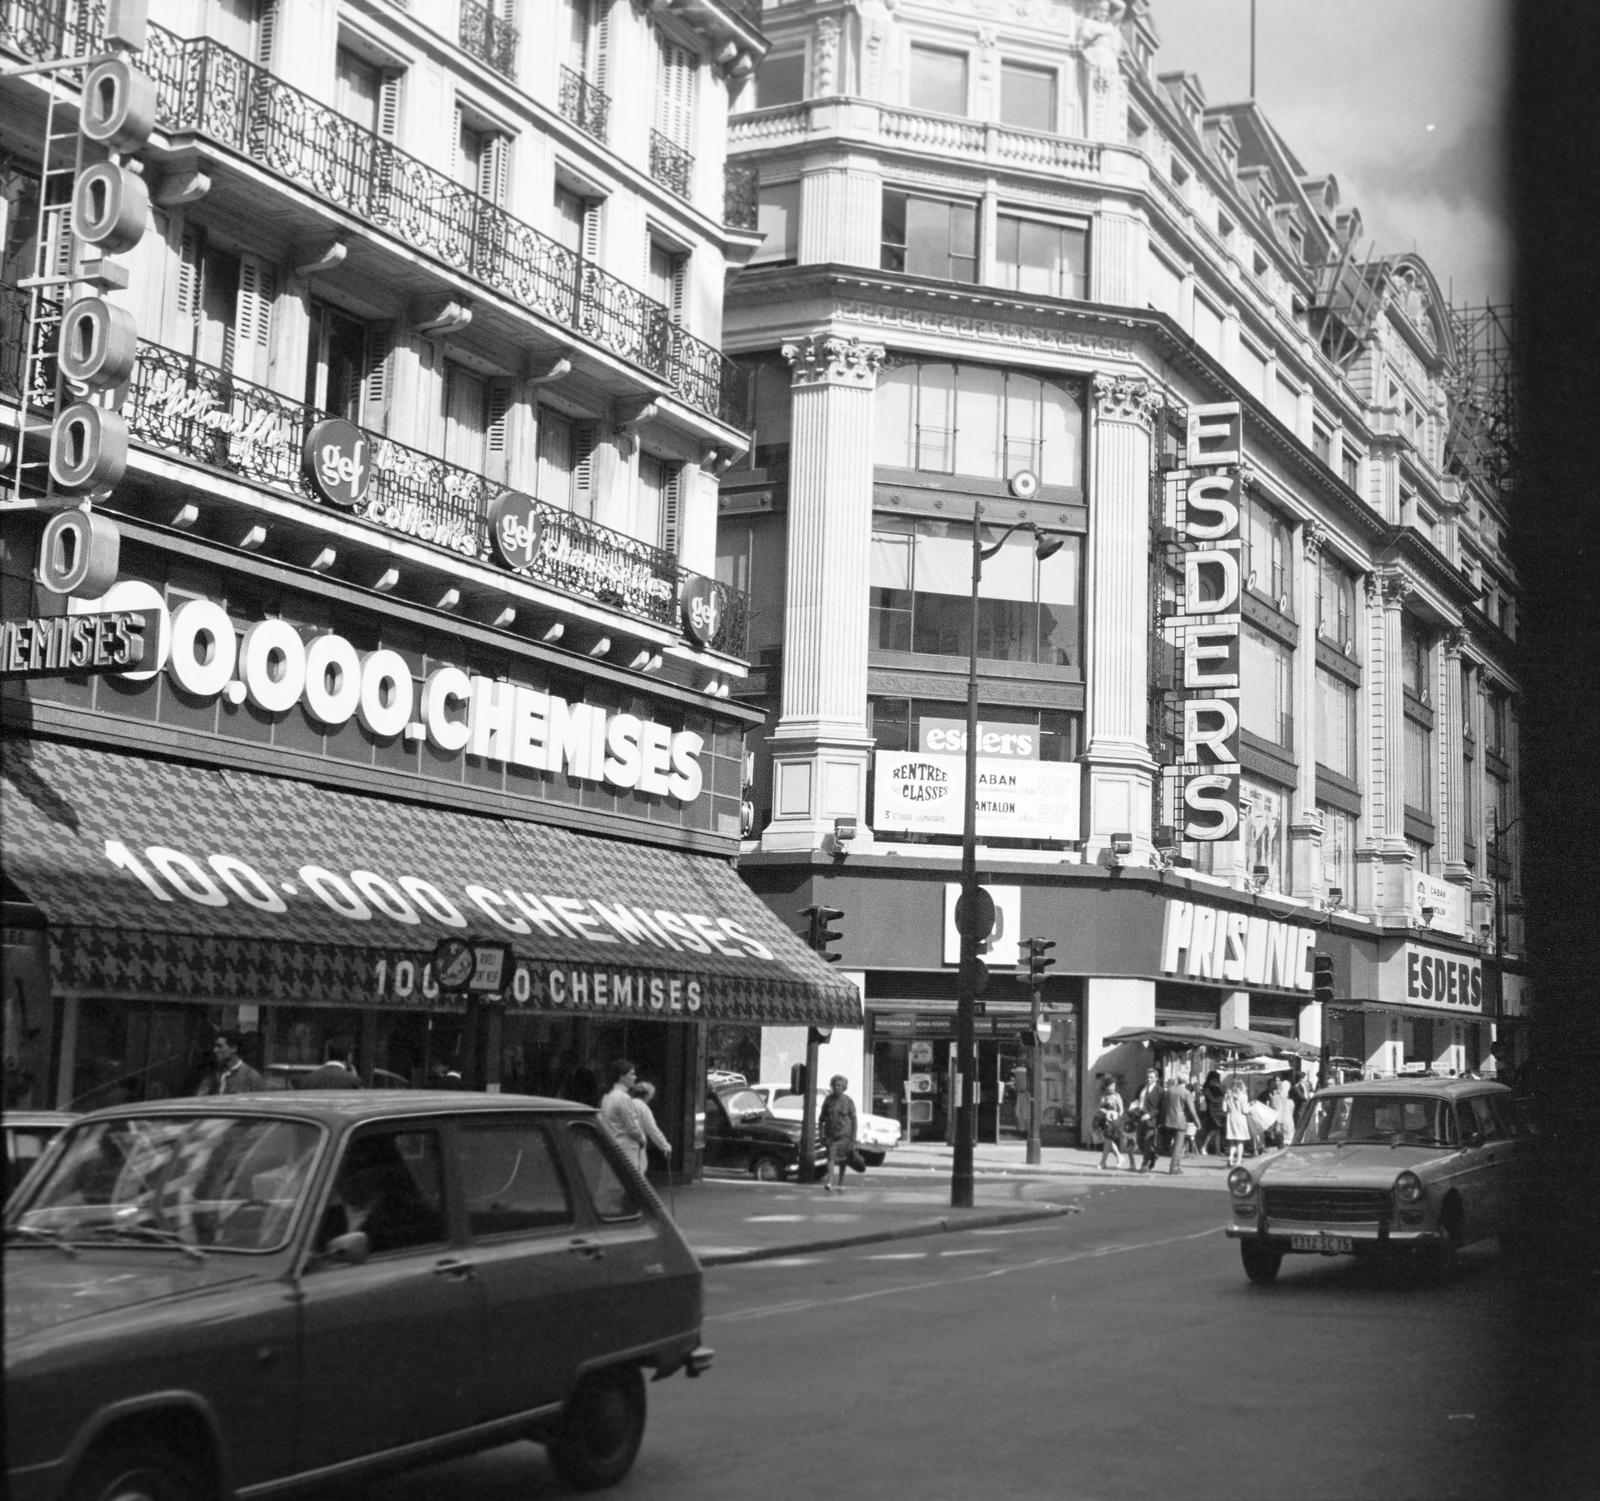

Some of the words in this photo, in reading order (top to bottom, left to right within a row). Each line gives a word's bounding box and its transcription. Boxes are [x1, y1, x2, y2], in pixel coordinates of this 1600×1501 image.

[321, 441, 364, 498] gef
[502, 511, 538, 560] gef
[691, 590, 717, 637] gef
[1184, 401, 1240, 838] ESDERS
[0, 613, 146, 671] EMISES
[892, 762, 948, 782] RENTREE
[902, 783, 949, 802] CLASSES
[975, 774, 1017, 786] ABAN
[975, 801, 1016, 814] ANTALON
[105, 839, 468, 930] 100.000
[465, 884, 776, 962] CHEMISES
[550, 969, 701, 1012] CHEMISES
[1407, 952, 1482, 1008] ESDERS
